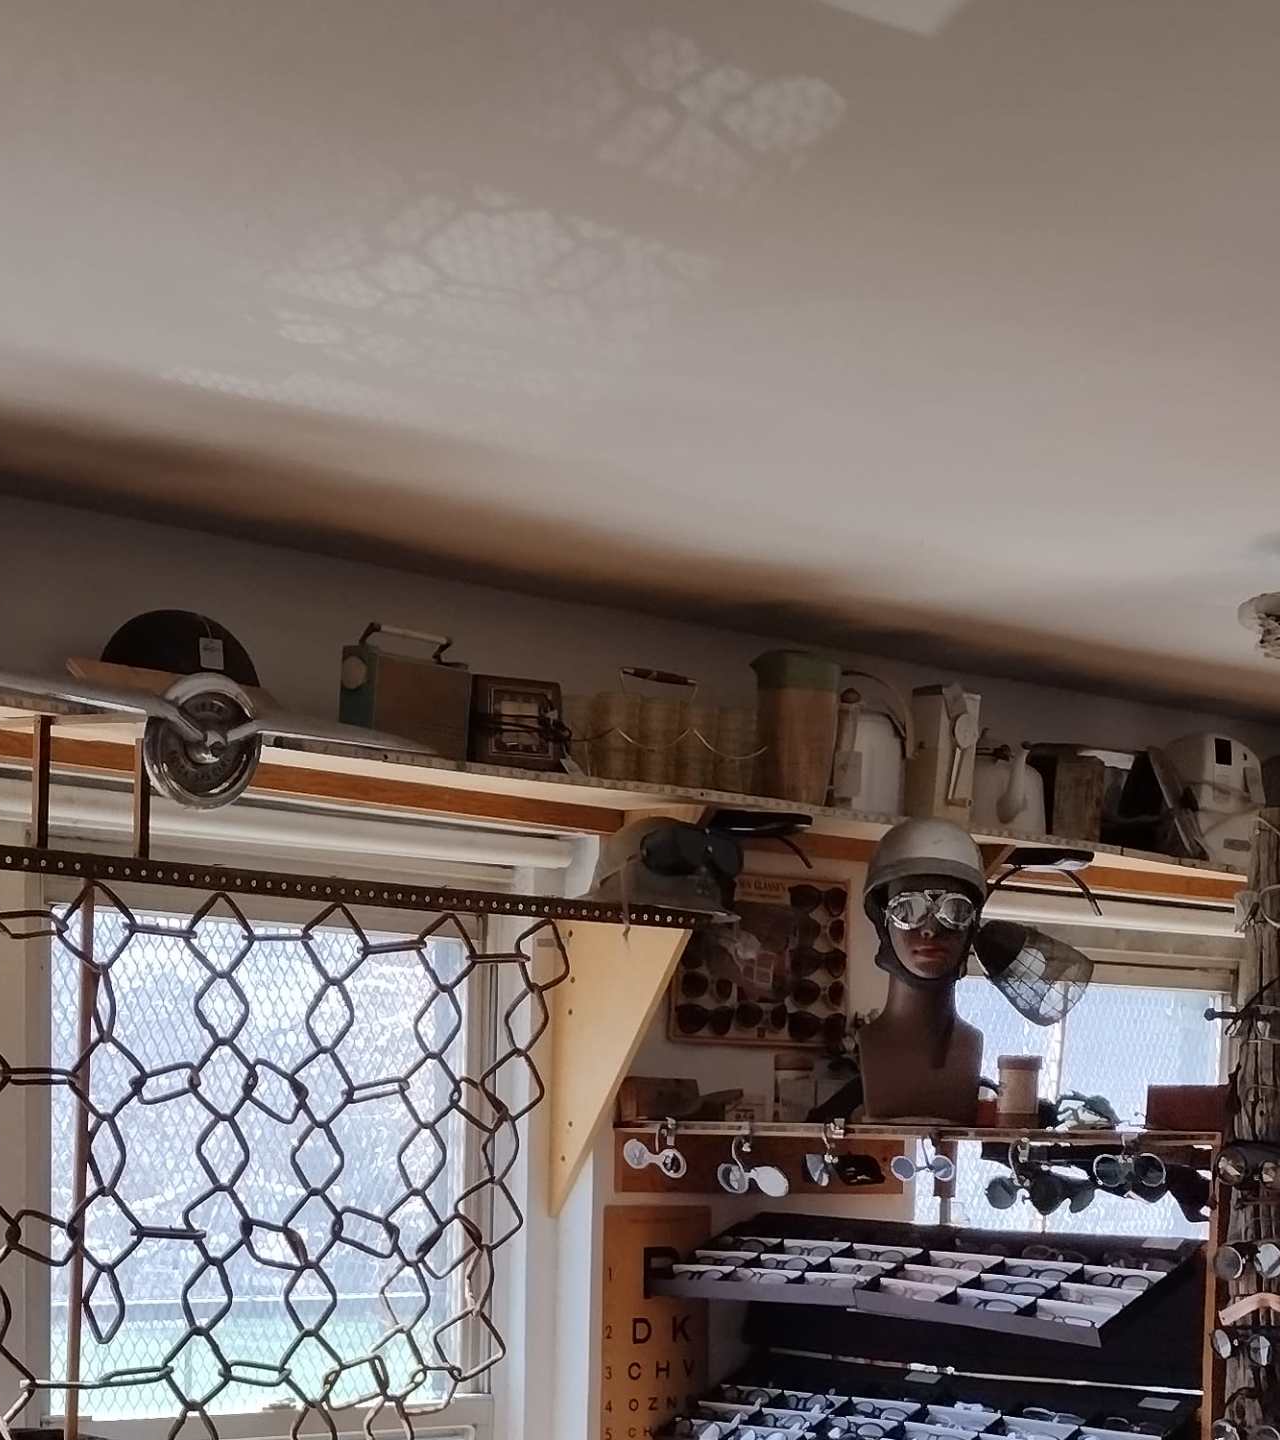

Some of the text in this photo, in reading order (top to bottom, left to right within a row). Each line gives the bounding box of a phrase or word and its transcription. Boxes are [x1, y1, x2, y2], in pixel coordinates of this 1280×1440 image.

[604, 1315, 692, 1345] 2 D K
[604, 1359, 696, 1380] 3 C H V
[604, 1399, 613, 1413] 4
[647, 1397, 659, 1411] Z
[604, 1427, 613, 1440] 5
